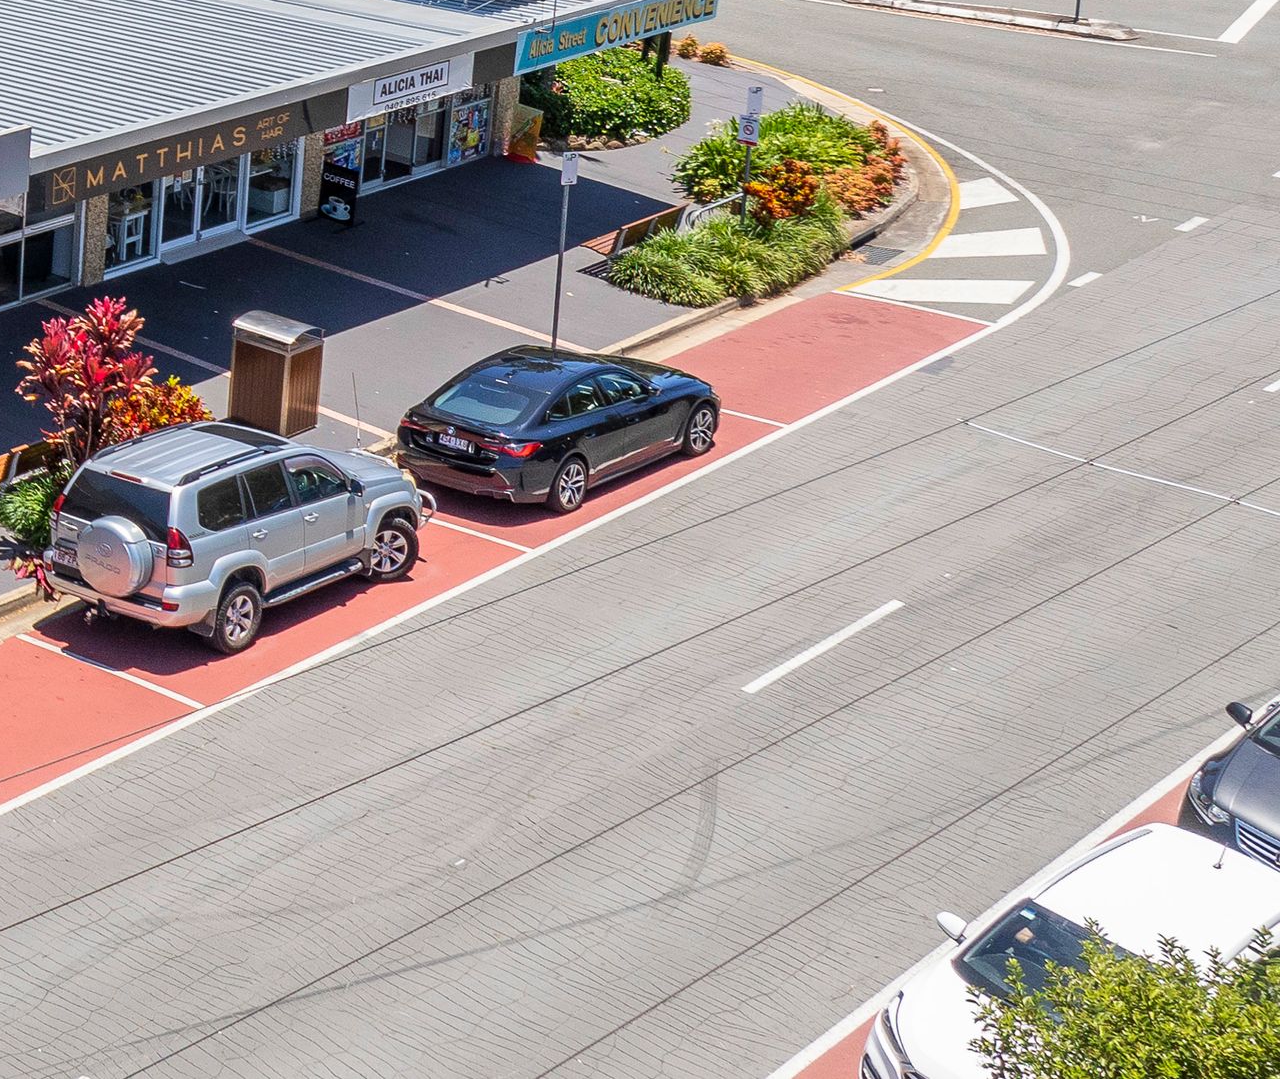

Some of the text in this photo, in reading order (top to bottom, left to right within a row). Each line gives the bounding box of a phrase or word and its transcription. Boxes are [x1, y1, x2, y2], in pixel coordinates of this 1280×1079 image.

[528, 34, 554, 60] Alicia
[558, 28, 587, 52] Street
[379, 67, 444, 98] ALICIA THAI
[384, 100, 404, 112] 0402
[255, 111, 291, 131] ART OF
[261, 126, 284, 141] HAIR
[86, 126, 247, 190] MATTHIAS
[323, 171, 357, 190] COFFEE
[84, 553, 121, 575] PRADO
